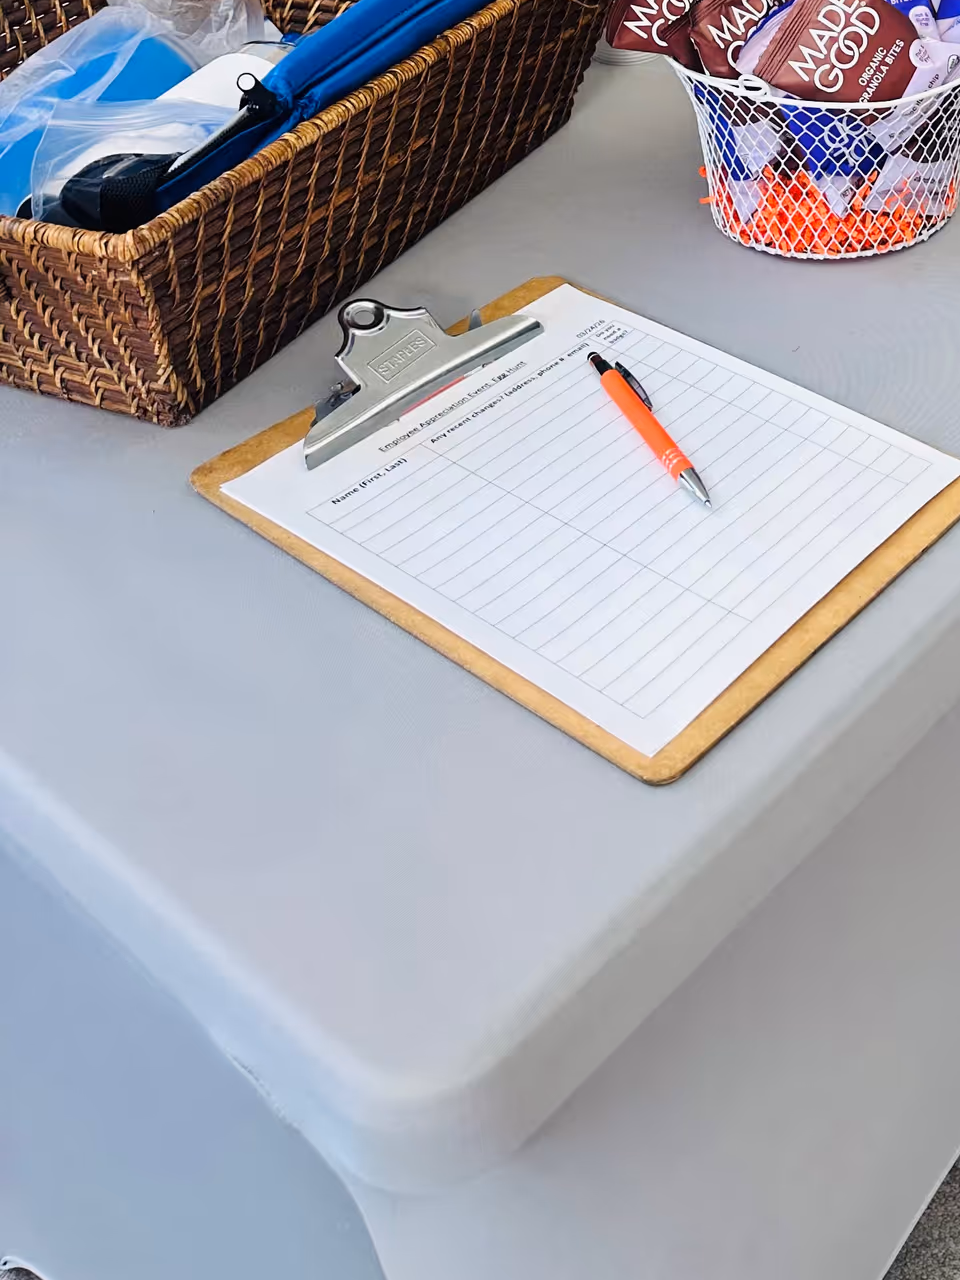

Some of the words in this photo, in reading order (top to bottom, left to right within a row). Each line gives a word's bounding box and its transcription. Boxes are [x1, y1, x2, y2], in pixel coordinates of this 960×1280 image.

[813, 6, 881, 93] GOOD
[858, 46, 888, 87] ORGANIC
[859, 66, 890, 104] GRANOLA
[886, 39, 905, 66] BITES
[928, 73, 940, 89] chip
[378, 336, 427, 375] STAPLES
[378, 426, 419, 453] Employee
[419, 394, 470, 428] Appreciation
[505, 360, 528, 377] Hunt
[430, 432, 447, 445] Any
[446, 416, 471, 433] recent
[471, 395, 505, 419] changes?
[537, 361, 560, 378] phone
[567, 342, 590, 358] email)
[331, 486, 360, 505] Name
[358, 471, 387, 489] (First,
[384, 457, 408, 473] Last)
